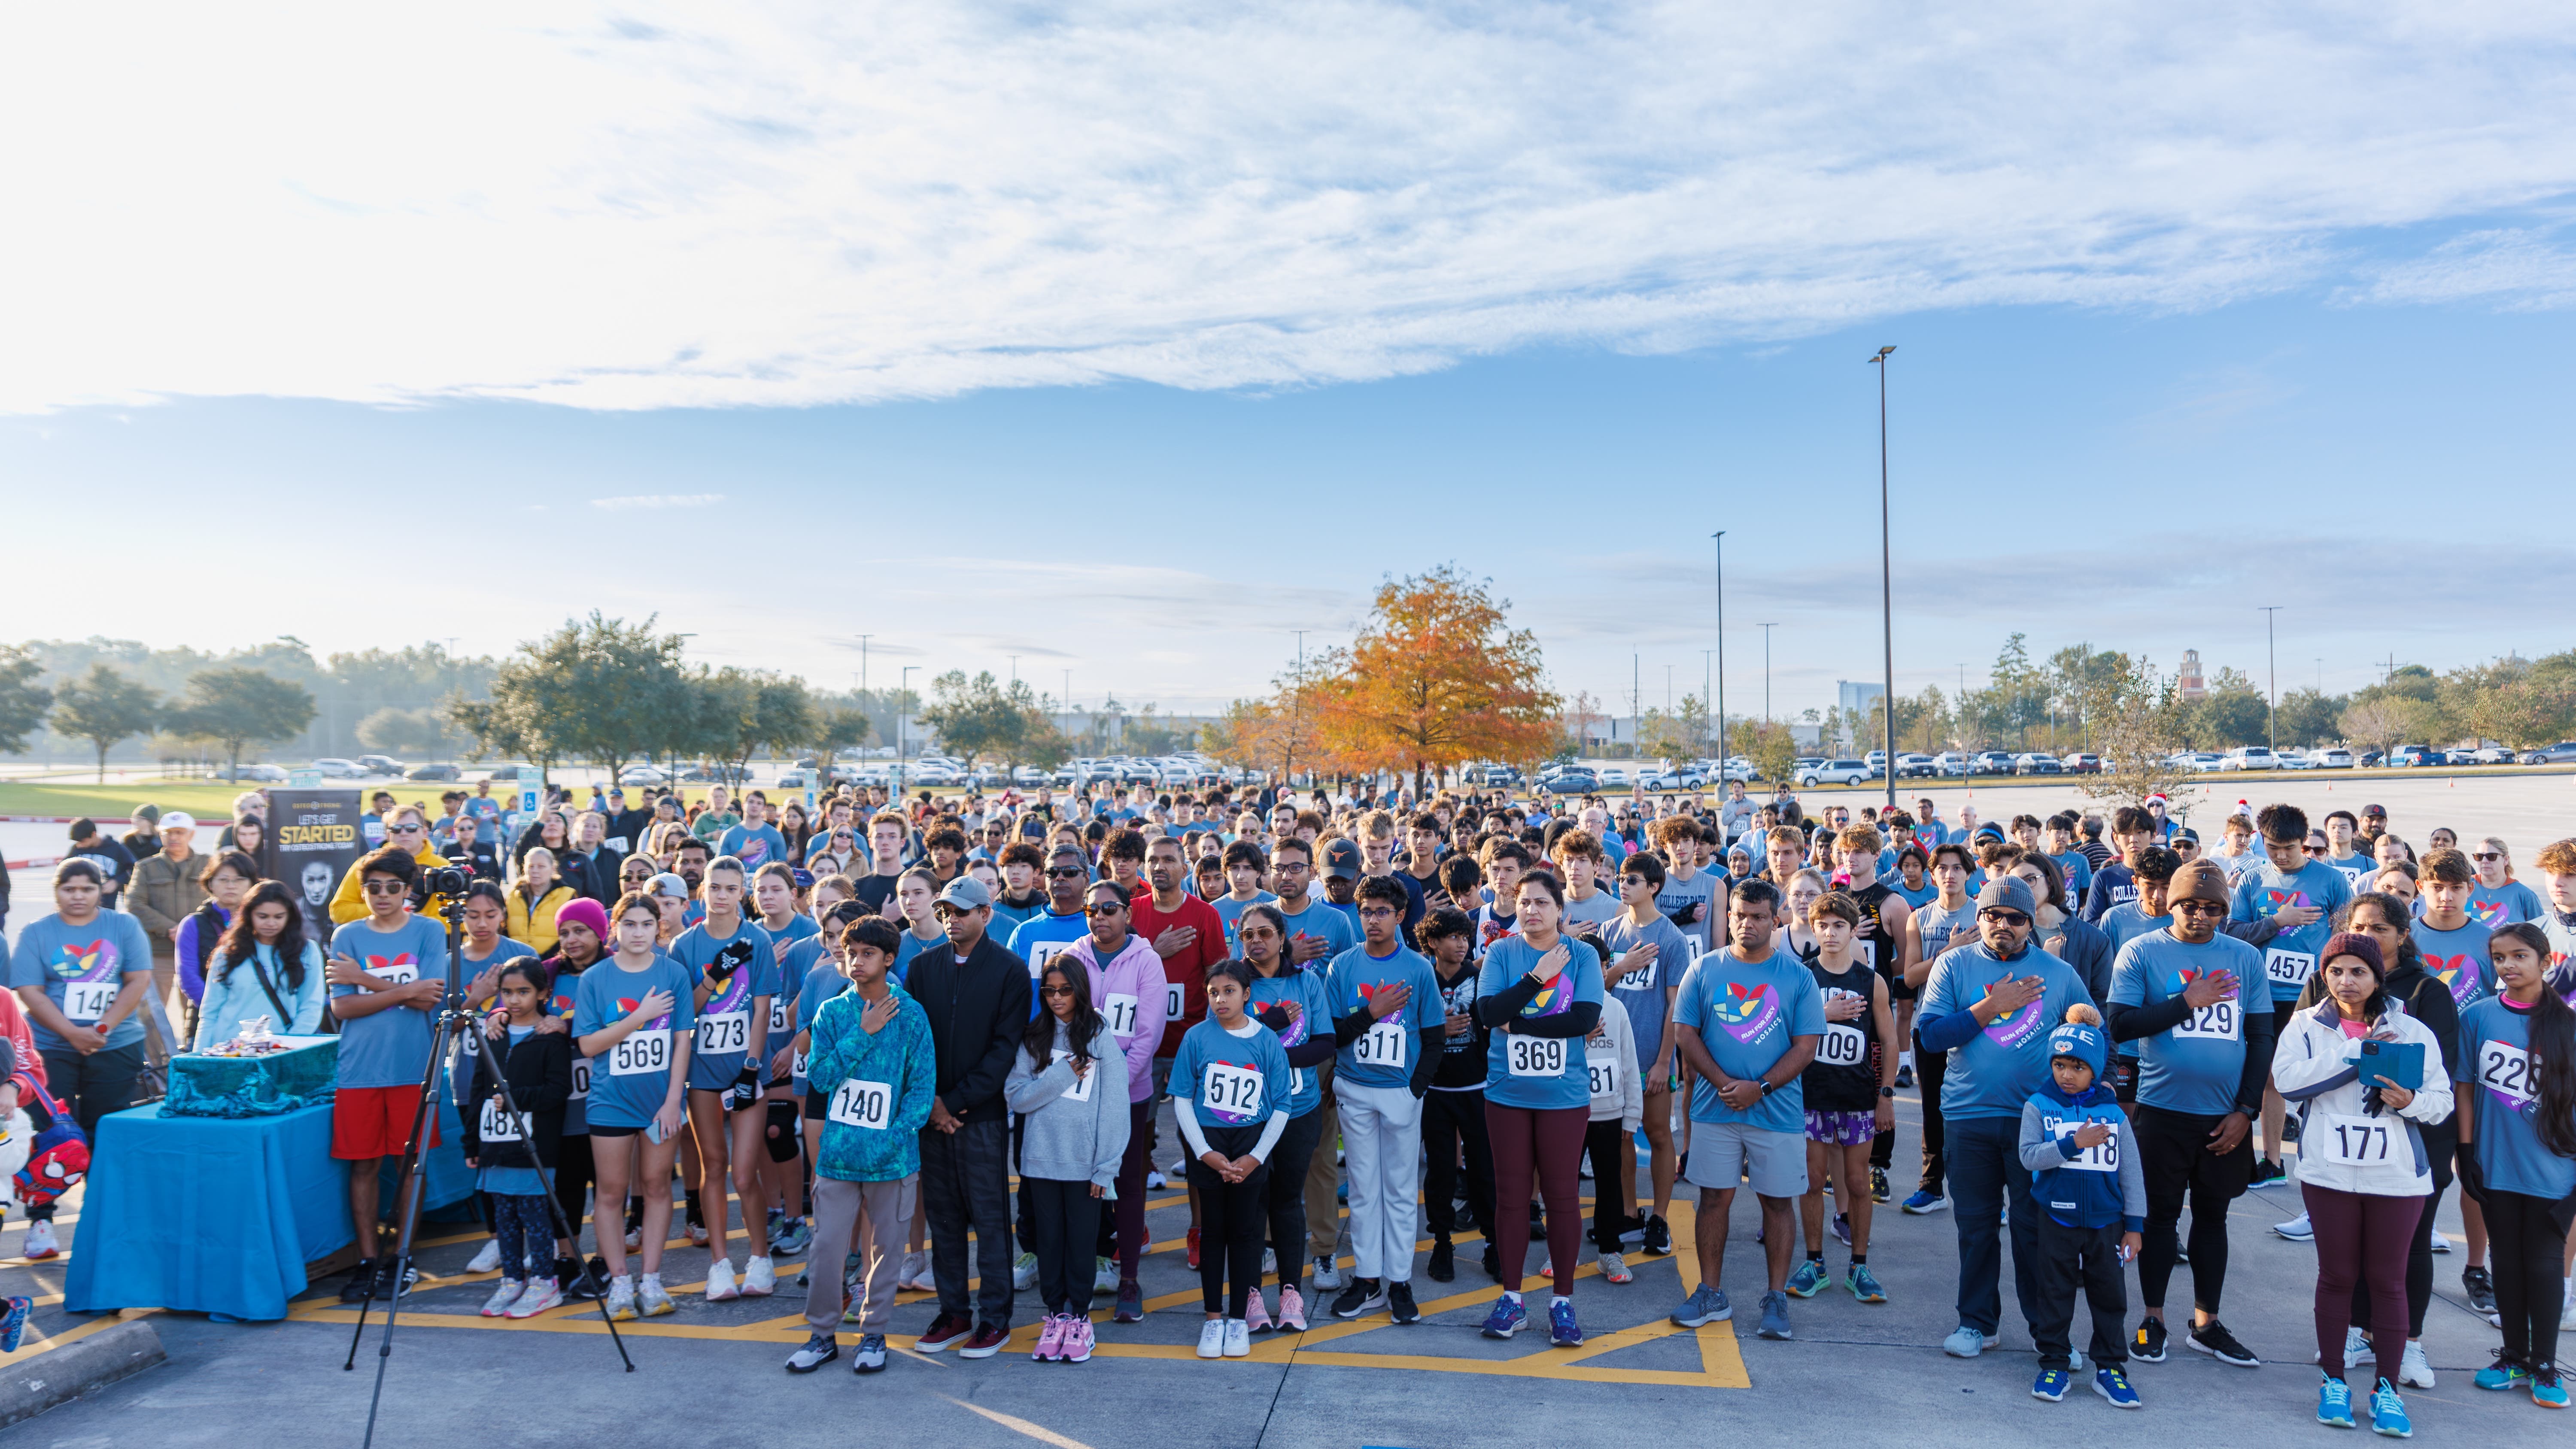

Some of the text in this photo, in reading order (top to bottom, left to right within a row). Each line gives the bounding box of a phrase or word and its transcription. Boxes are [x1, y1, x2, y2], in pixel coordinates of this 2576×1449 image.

[279, 824, 355, 844] STARTED
[298, 814, 337, 826] LET'S GET
[1660, 894, 1688, 909] COLLEGE
[2113, 885, 2140, 902] COLLE
[1869, 904, 1880, 923] NAVY
[1923, 927, 1952, 942] COLLEG
[2289, 924, 2306, 937] MOSA
[2269, 956, 2309, 981] 457
[2454, 976, 2475, 1000] FOR JEEV
[2457, 987, 2482, 1012] MOSAICS
[1561, 994, 1571, 1011] JEEV
[1114, 1002, 1137, 1032] 11
[1741, 1005, 1775, 1039] RUN FOR JEEV
[1754, 1017, 1781, 1045] MOSAICS
[2000, 1009, 2038, 1042] RUN FOR JEEV
[704, 1018, 744, 1048] 273
[1283, 1021, 1302, 1047] FOR JEEV
[1359, 1030, 1398, 1060] 511
[1589, 1038, 1614, 1048] das
[1818, 1032, 1858, 1061] 109
[2015, 1021, 2044, 1049] MOSAICS
[618, 1037, 663, 1069] 569
[1514, 1040, 1561, 1071] 369
[1211, 1072, 1256, 1109] 512
[1589, 1065, 1613, 1093] 81
[841, 1086, 884, 1122] 140
[2335, 1124, 2387, 1160] 177
